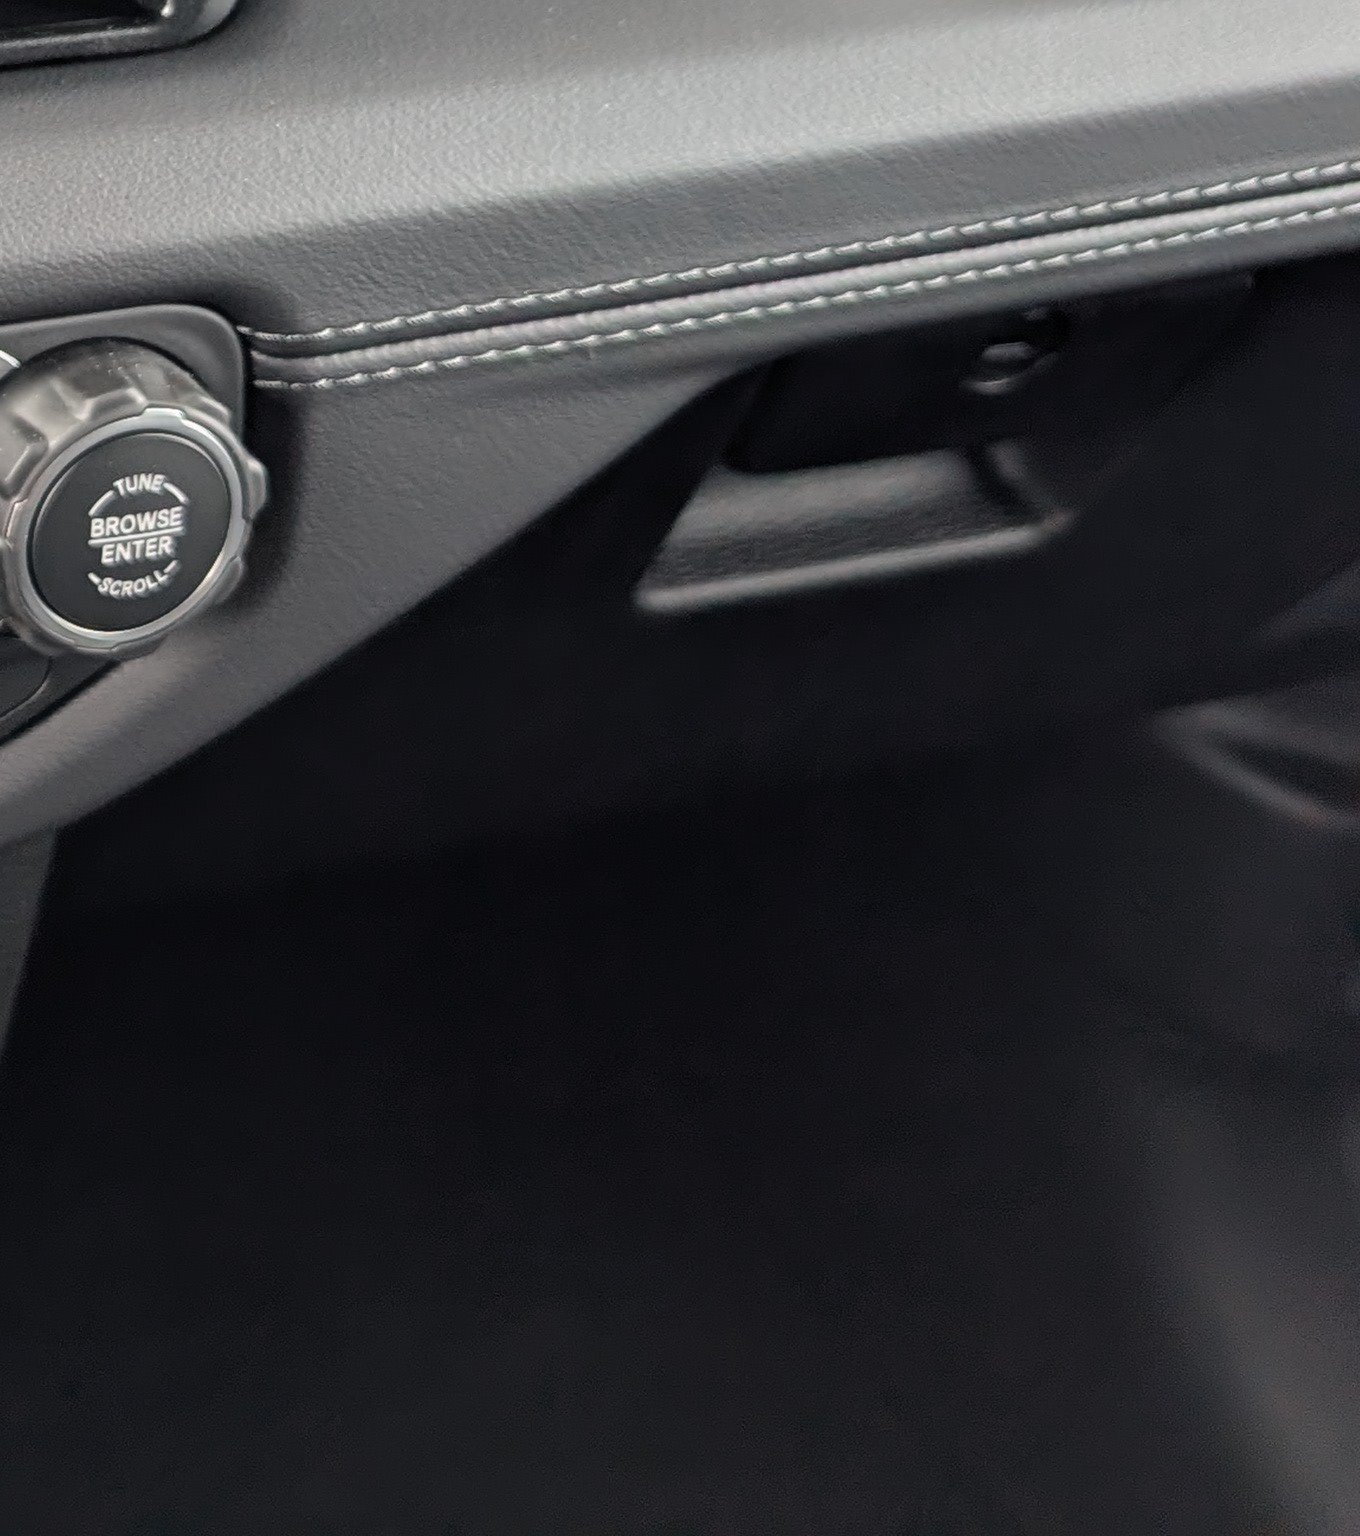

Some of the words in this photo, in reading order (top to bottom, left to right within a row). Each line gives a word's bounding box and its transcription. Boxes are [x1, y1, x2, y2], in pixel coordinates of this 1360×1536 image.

[113, 473, 166, 496] TUNE
[91, 506, 184, 537] BROWSE
[101, 536, 175, 565] ENTER
[98, 570, 168, 597] SCROLL
